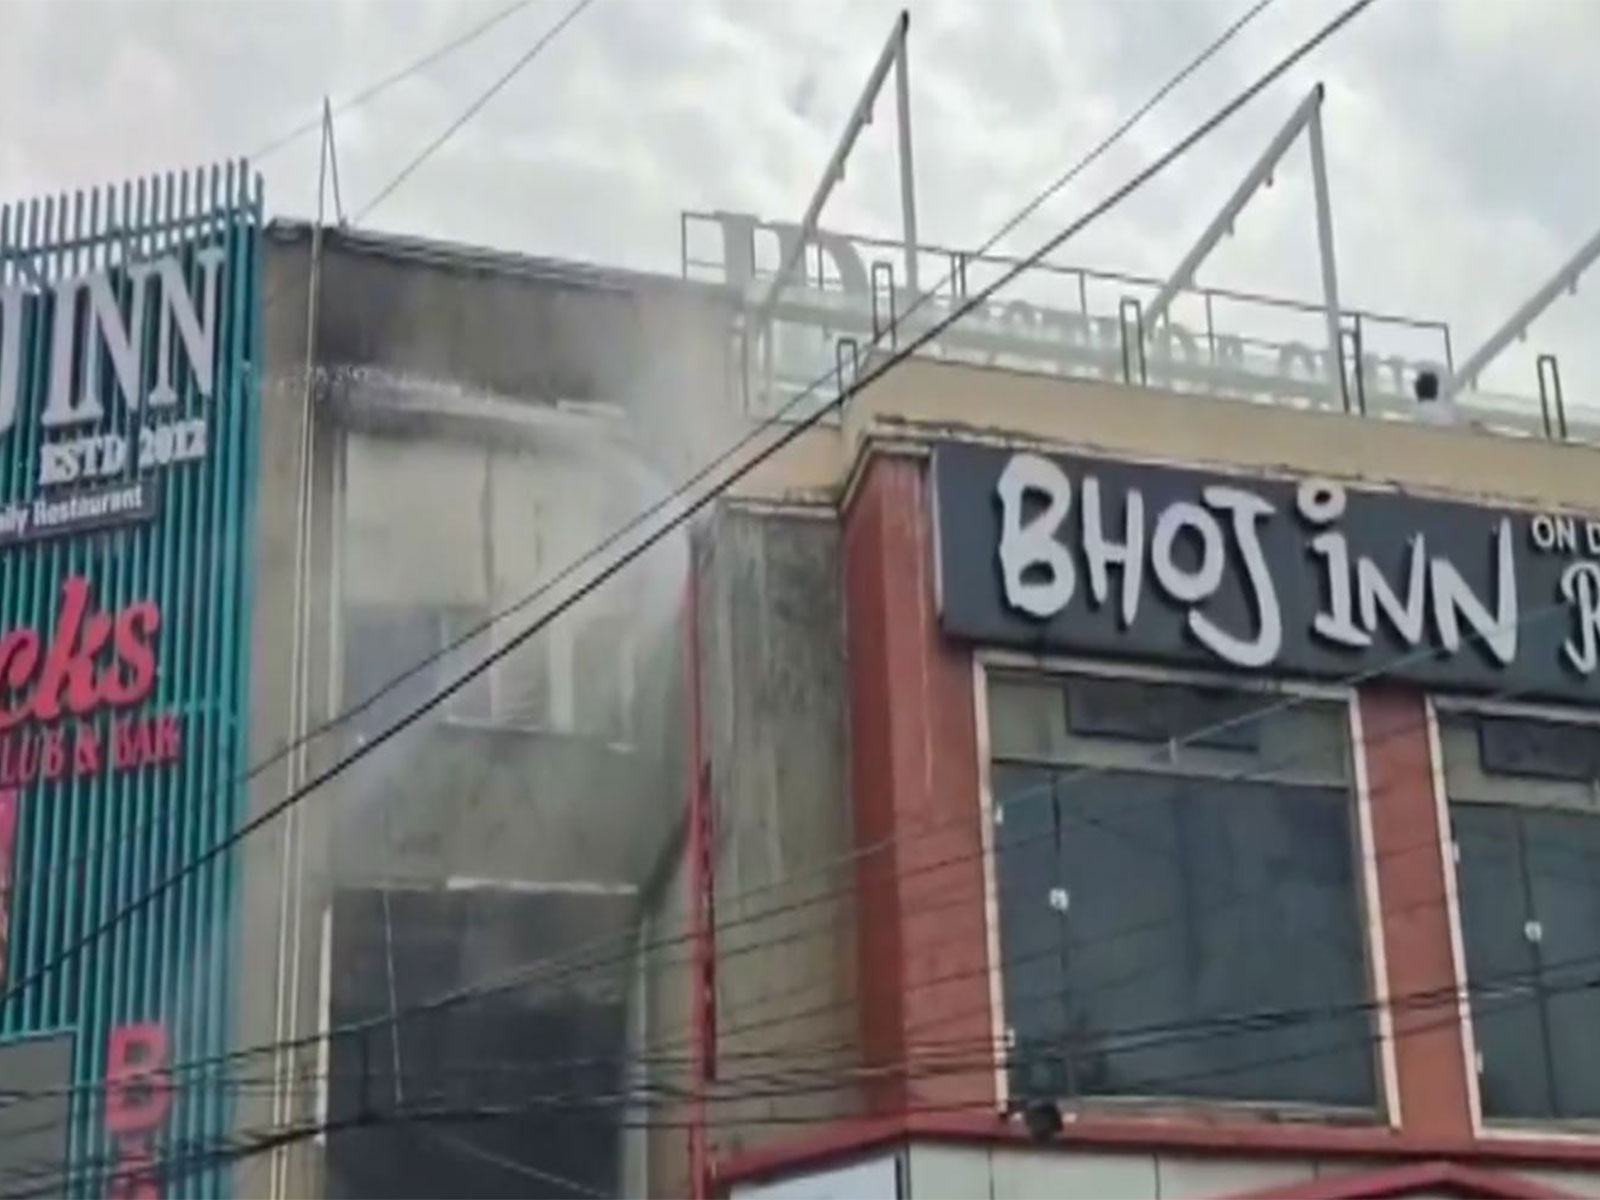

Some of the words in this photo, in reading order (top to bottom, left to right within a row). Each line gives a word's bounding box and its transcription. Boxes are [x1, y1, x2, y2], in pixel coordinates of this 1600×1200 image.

[42, 249, 225, 428] INN
[997, 454, 1281, 667] BHOJ
[1532, 515, 1576, 550] ON
[114, 711, 178, 772] BAR
